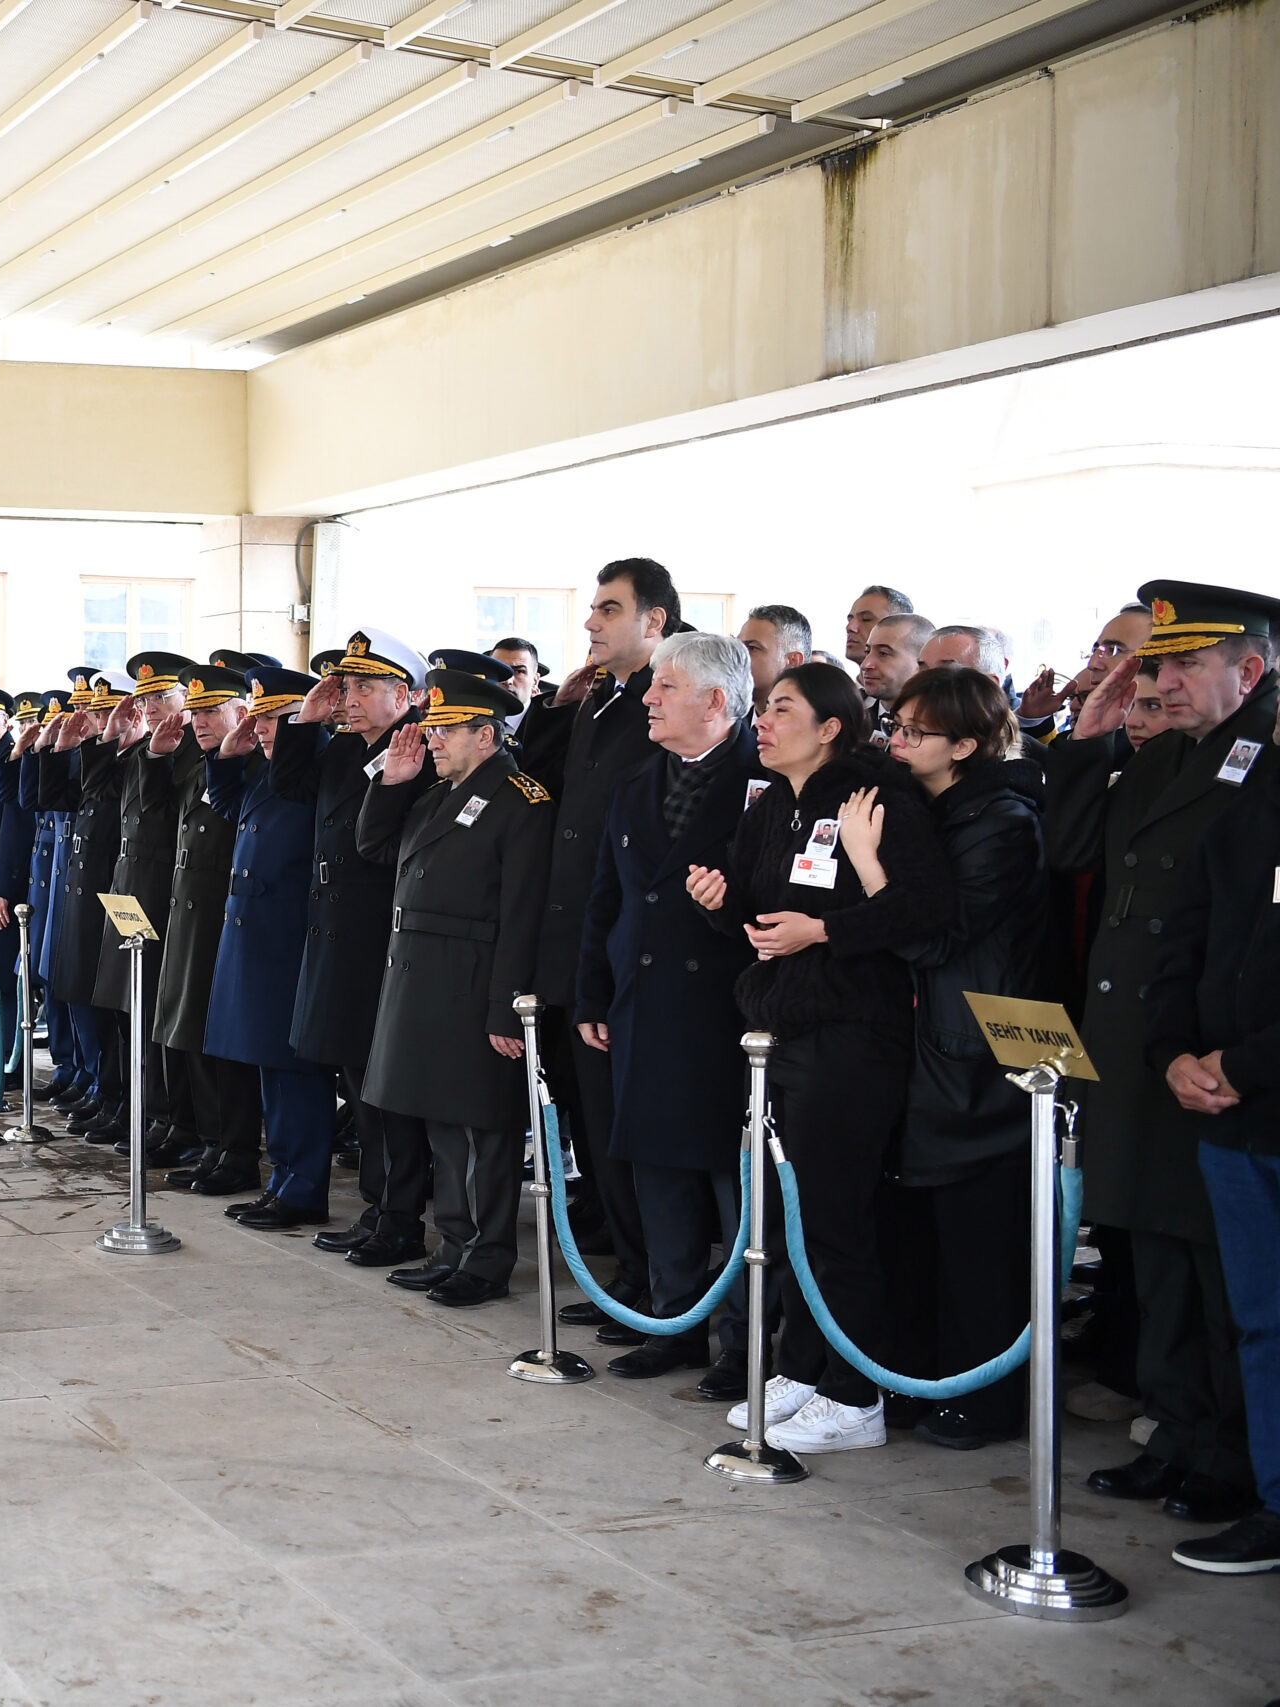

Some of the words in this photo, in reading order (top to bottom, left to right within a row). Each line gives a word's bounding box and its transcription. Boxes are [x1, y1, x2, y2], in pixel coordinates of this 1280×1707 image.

[113, 911, 143, 923] PROTOKOL
[985, 1021, 1024, 1041] ŞEHİT
[1025, 1027, 1075, 1049] YAKINI
